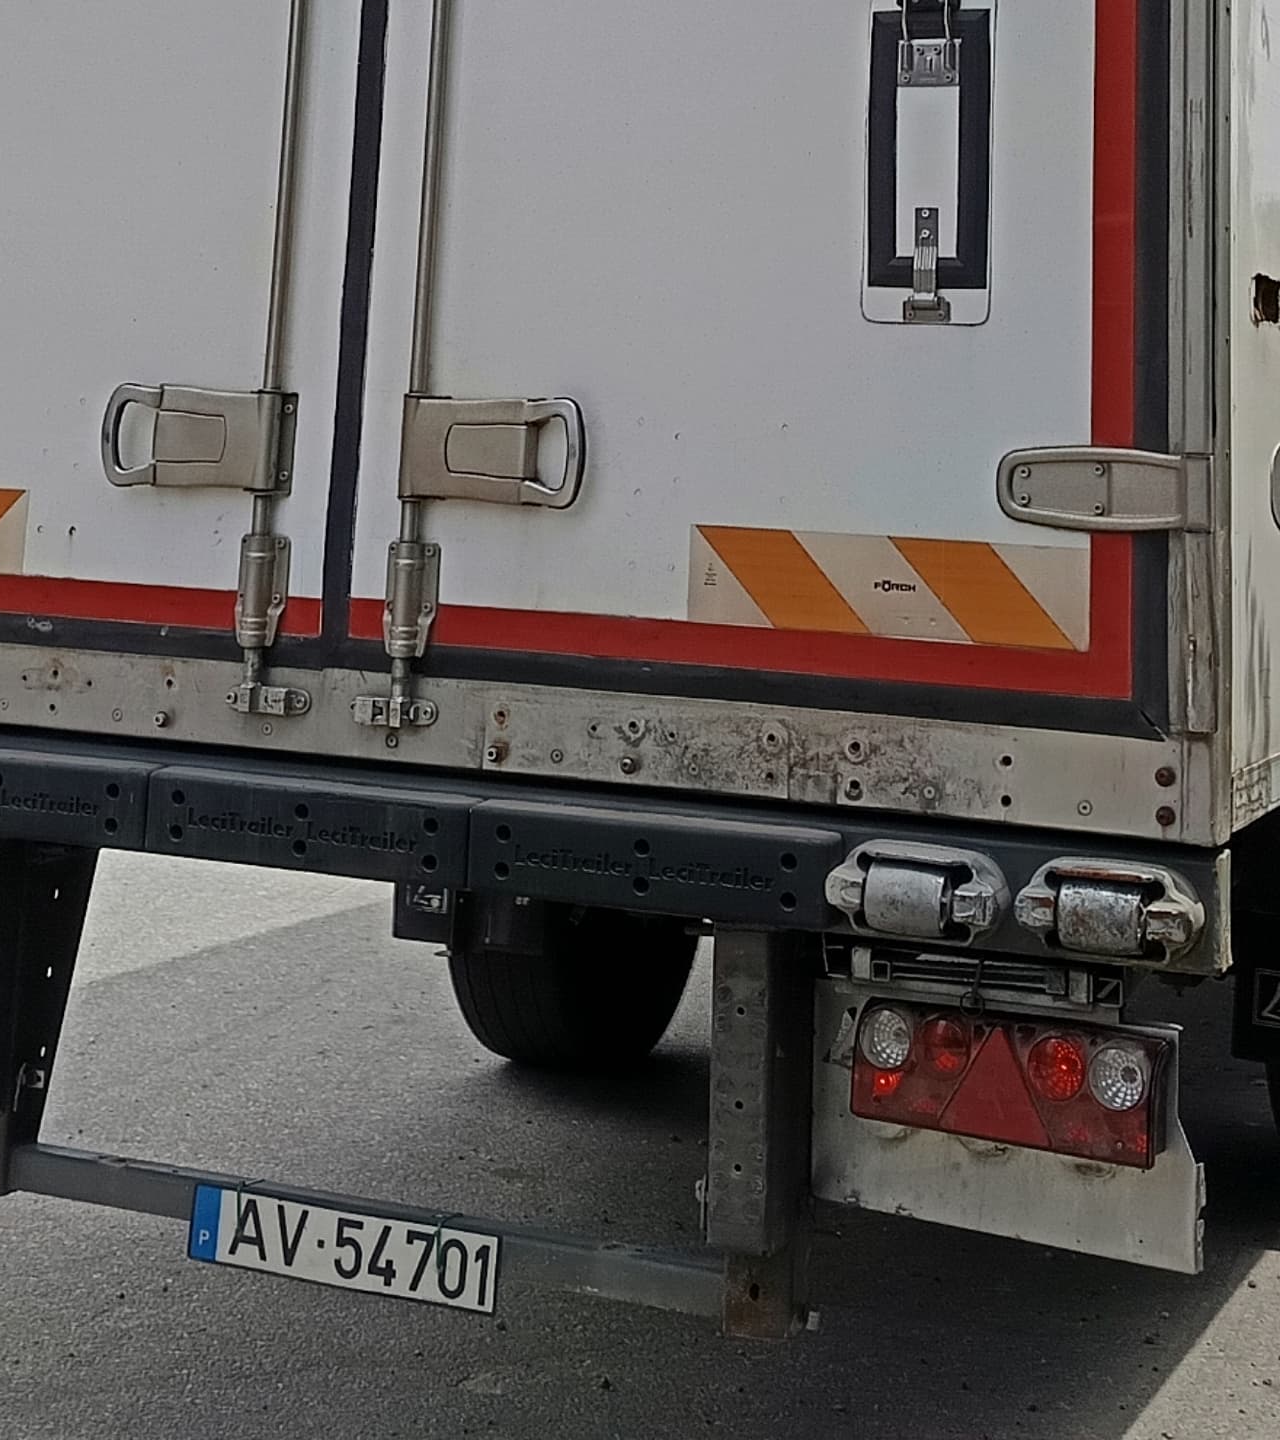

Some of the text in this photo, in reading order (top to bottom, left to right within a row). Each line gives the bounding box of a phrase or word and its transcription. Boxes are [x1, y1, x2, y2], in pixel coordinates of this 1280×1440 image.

[0, 788, 99, 817] LeciTrailer
[186, 806, 417, 854] LeciTrailer LeciTrailer
[513, 843, 776, 892] LeciTrailer LeciTrailer
[198, 1230, 209, 1246] P
